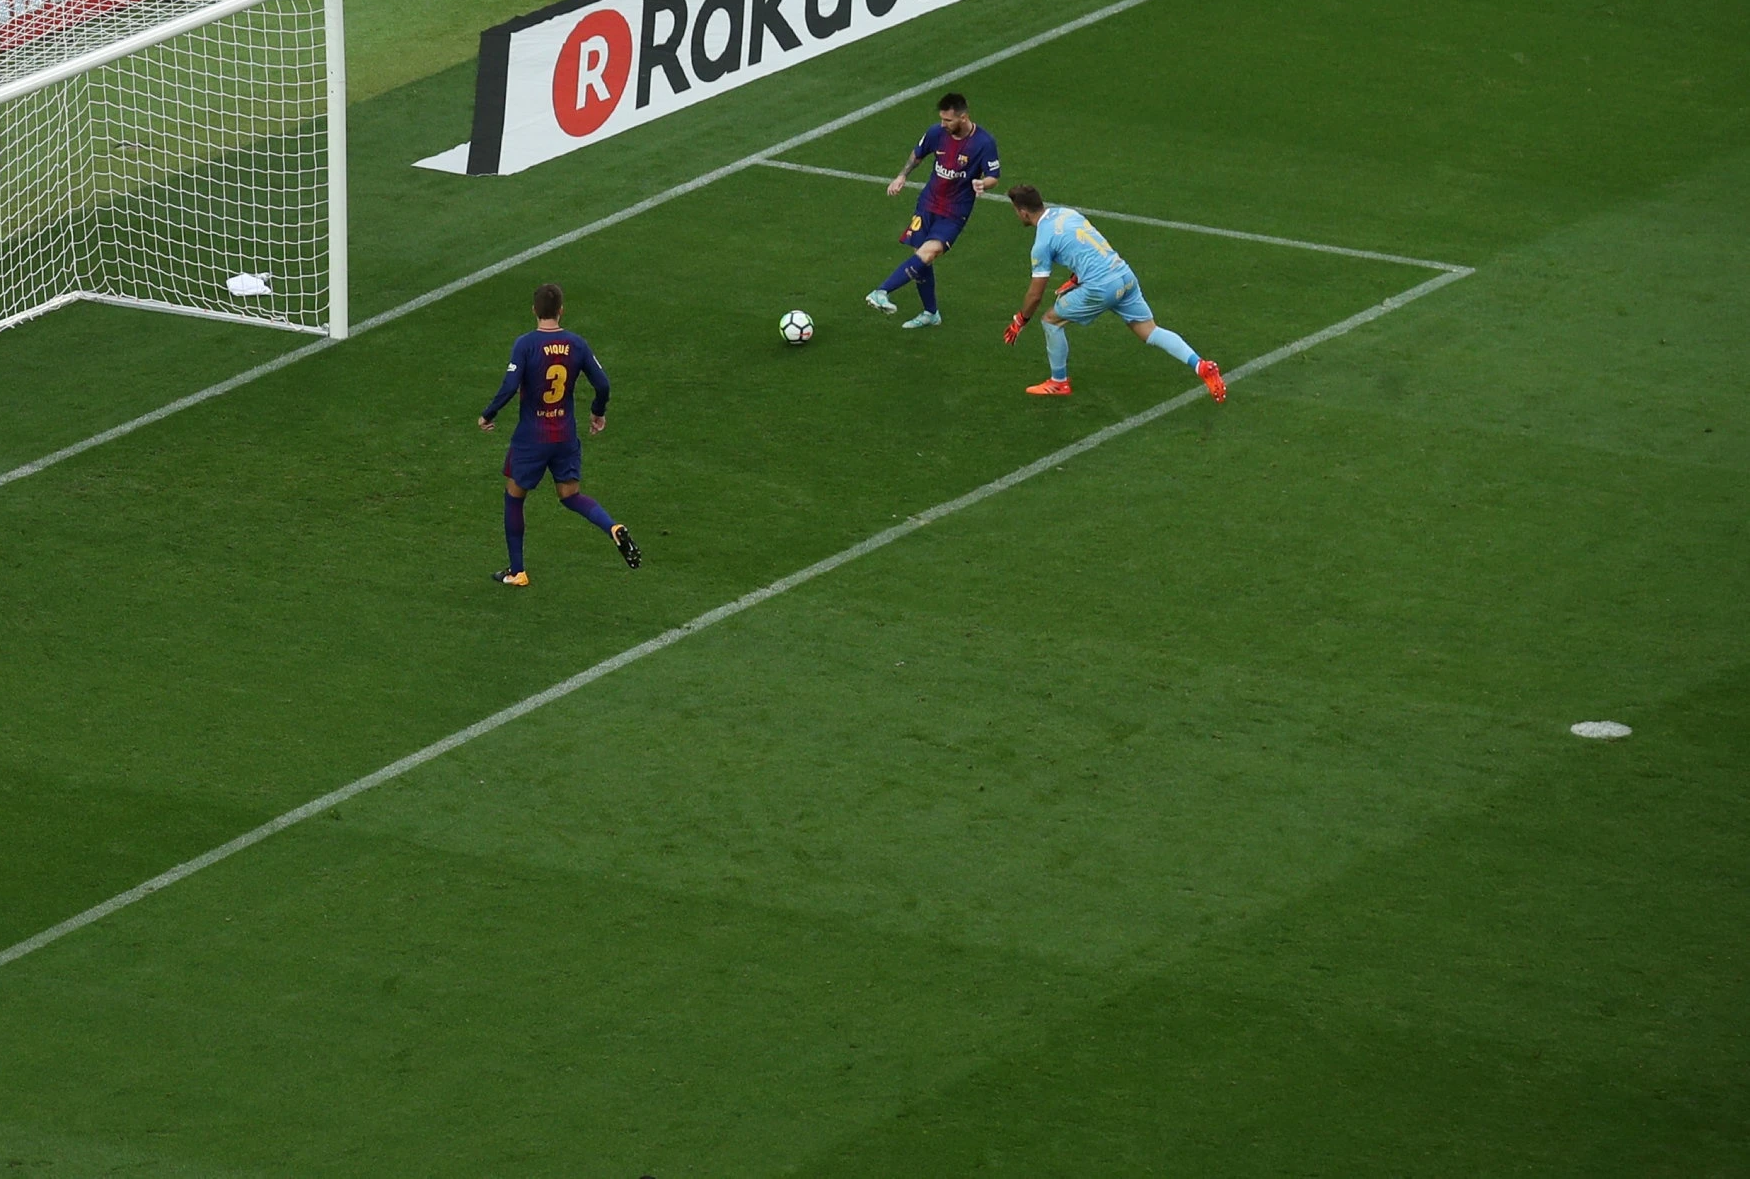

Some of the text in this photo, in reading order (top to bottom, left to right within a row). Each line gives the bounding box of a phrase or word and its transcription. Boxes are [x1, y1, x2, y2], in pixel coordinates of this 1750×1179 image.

[543, 344, 570, 356] PIQUÉ
[542, 364, 568, 404] 3
[537, 408, 558, 418] unicef
